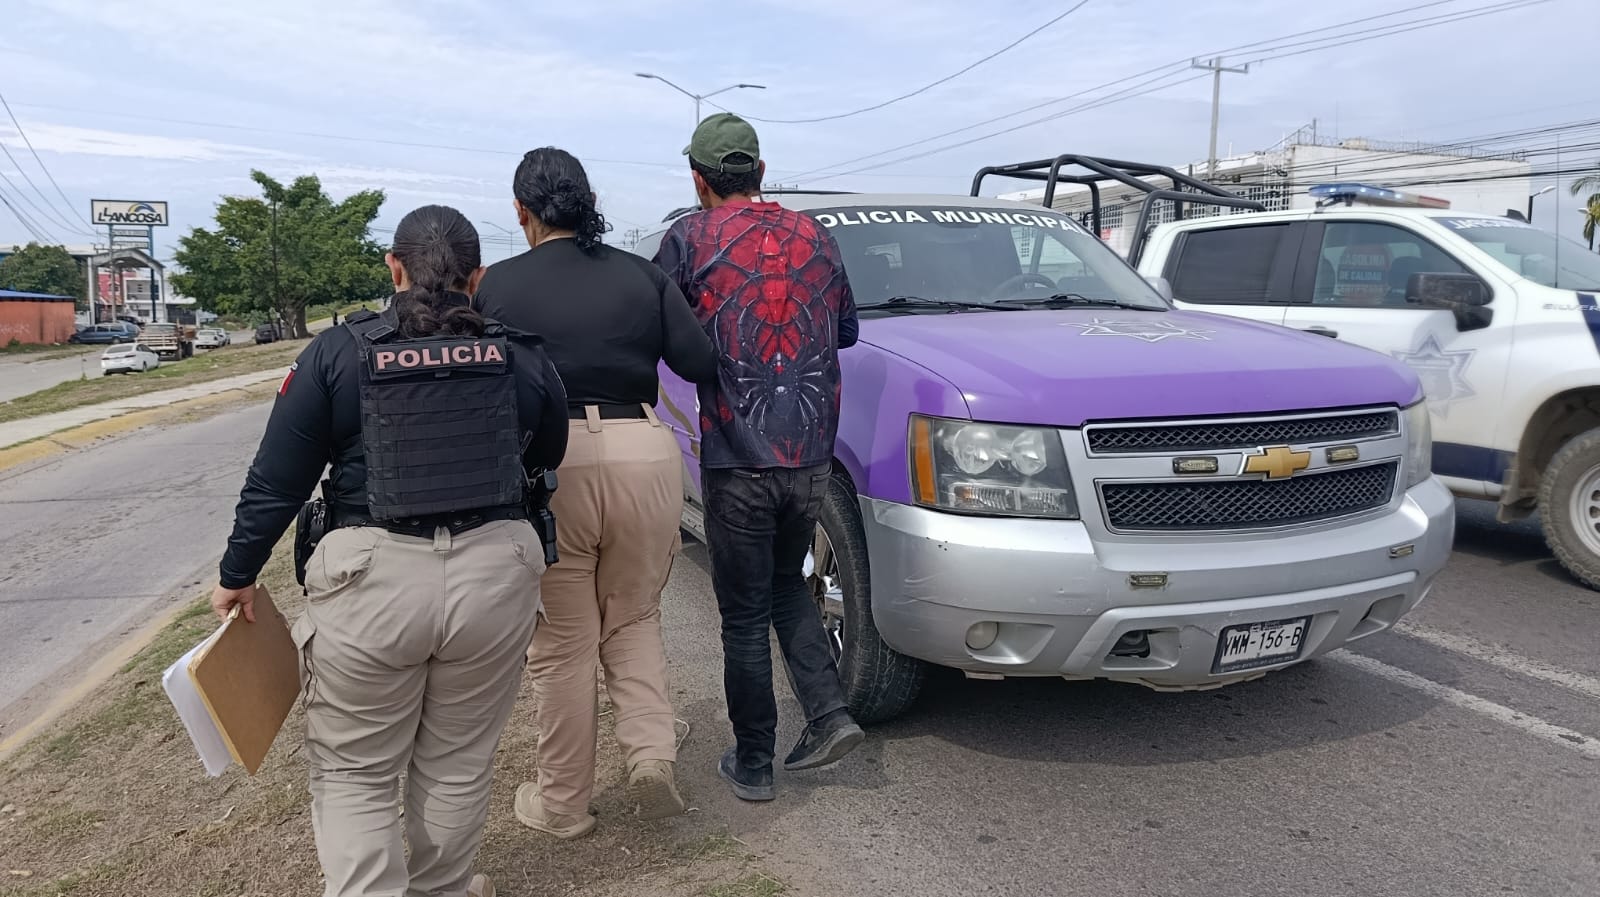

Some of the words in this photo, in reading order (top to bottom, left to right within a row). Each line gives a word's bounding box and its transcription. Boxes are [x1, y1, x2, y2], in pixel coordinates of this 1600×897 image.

[98, 207, 163, 223] LLANCOSA
[815, 210, 928, 228] OLICIA
[376, 341, 503, 370] POLICÍA
